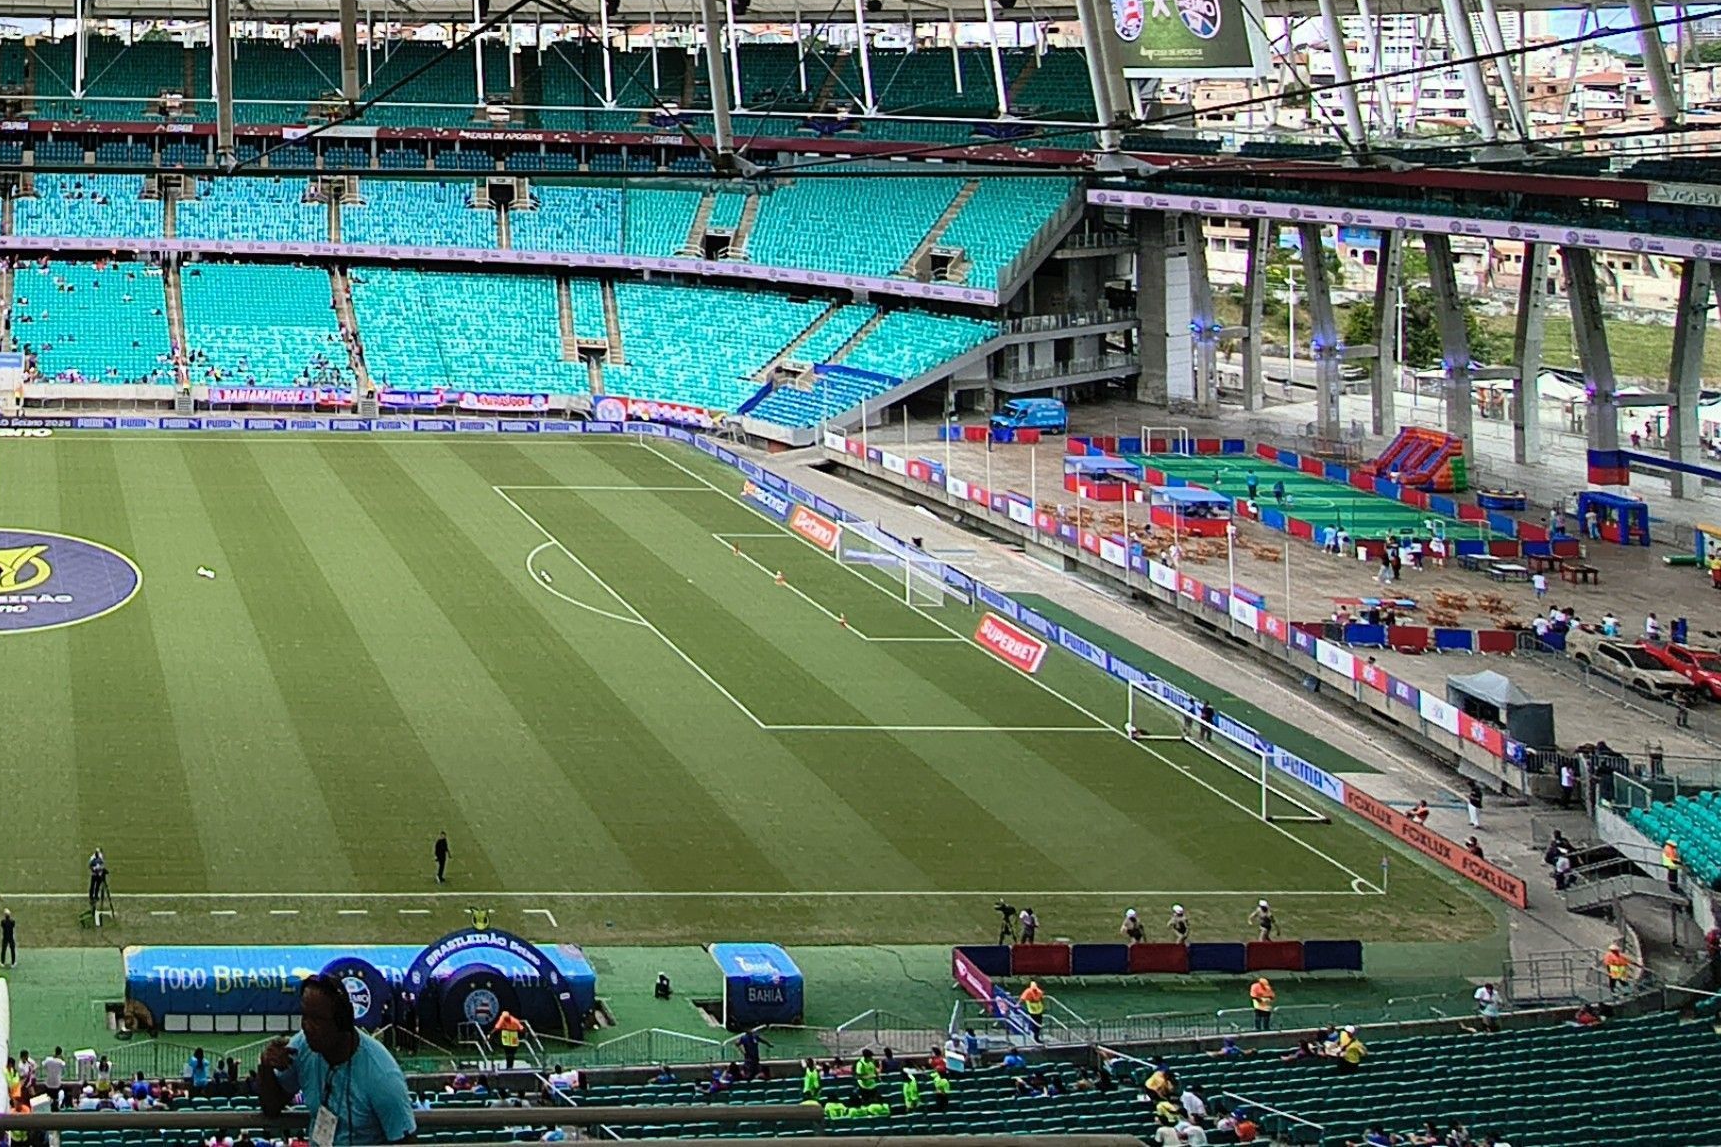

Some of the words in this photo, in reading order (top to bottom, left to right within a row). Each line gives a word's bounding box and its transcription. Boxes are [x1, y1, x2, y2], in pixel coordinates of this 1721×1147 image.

[1679, 190, 1718, 205] CASA
[980, 618, 1037, 662] SUPERBET
[1064, 632, 1092, 658] PUMA
[1281, 751, 1323, 789] PUMA
[1348, 792, 1393, 829] FOXLUX
[1401, 822, 1452, 861] FOXLUX
[1461, 856, 1519, 899] FOXLUX
[426, 931, 508, 967] BRASILEIRÃO
[152, 965, 207, 994] TODO
[213, 964, 296, 994] BRASIL
[748, 987, 784, 1003] BAHIA
